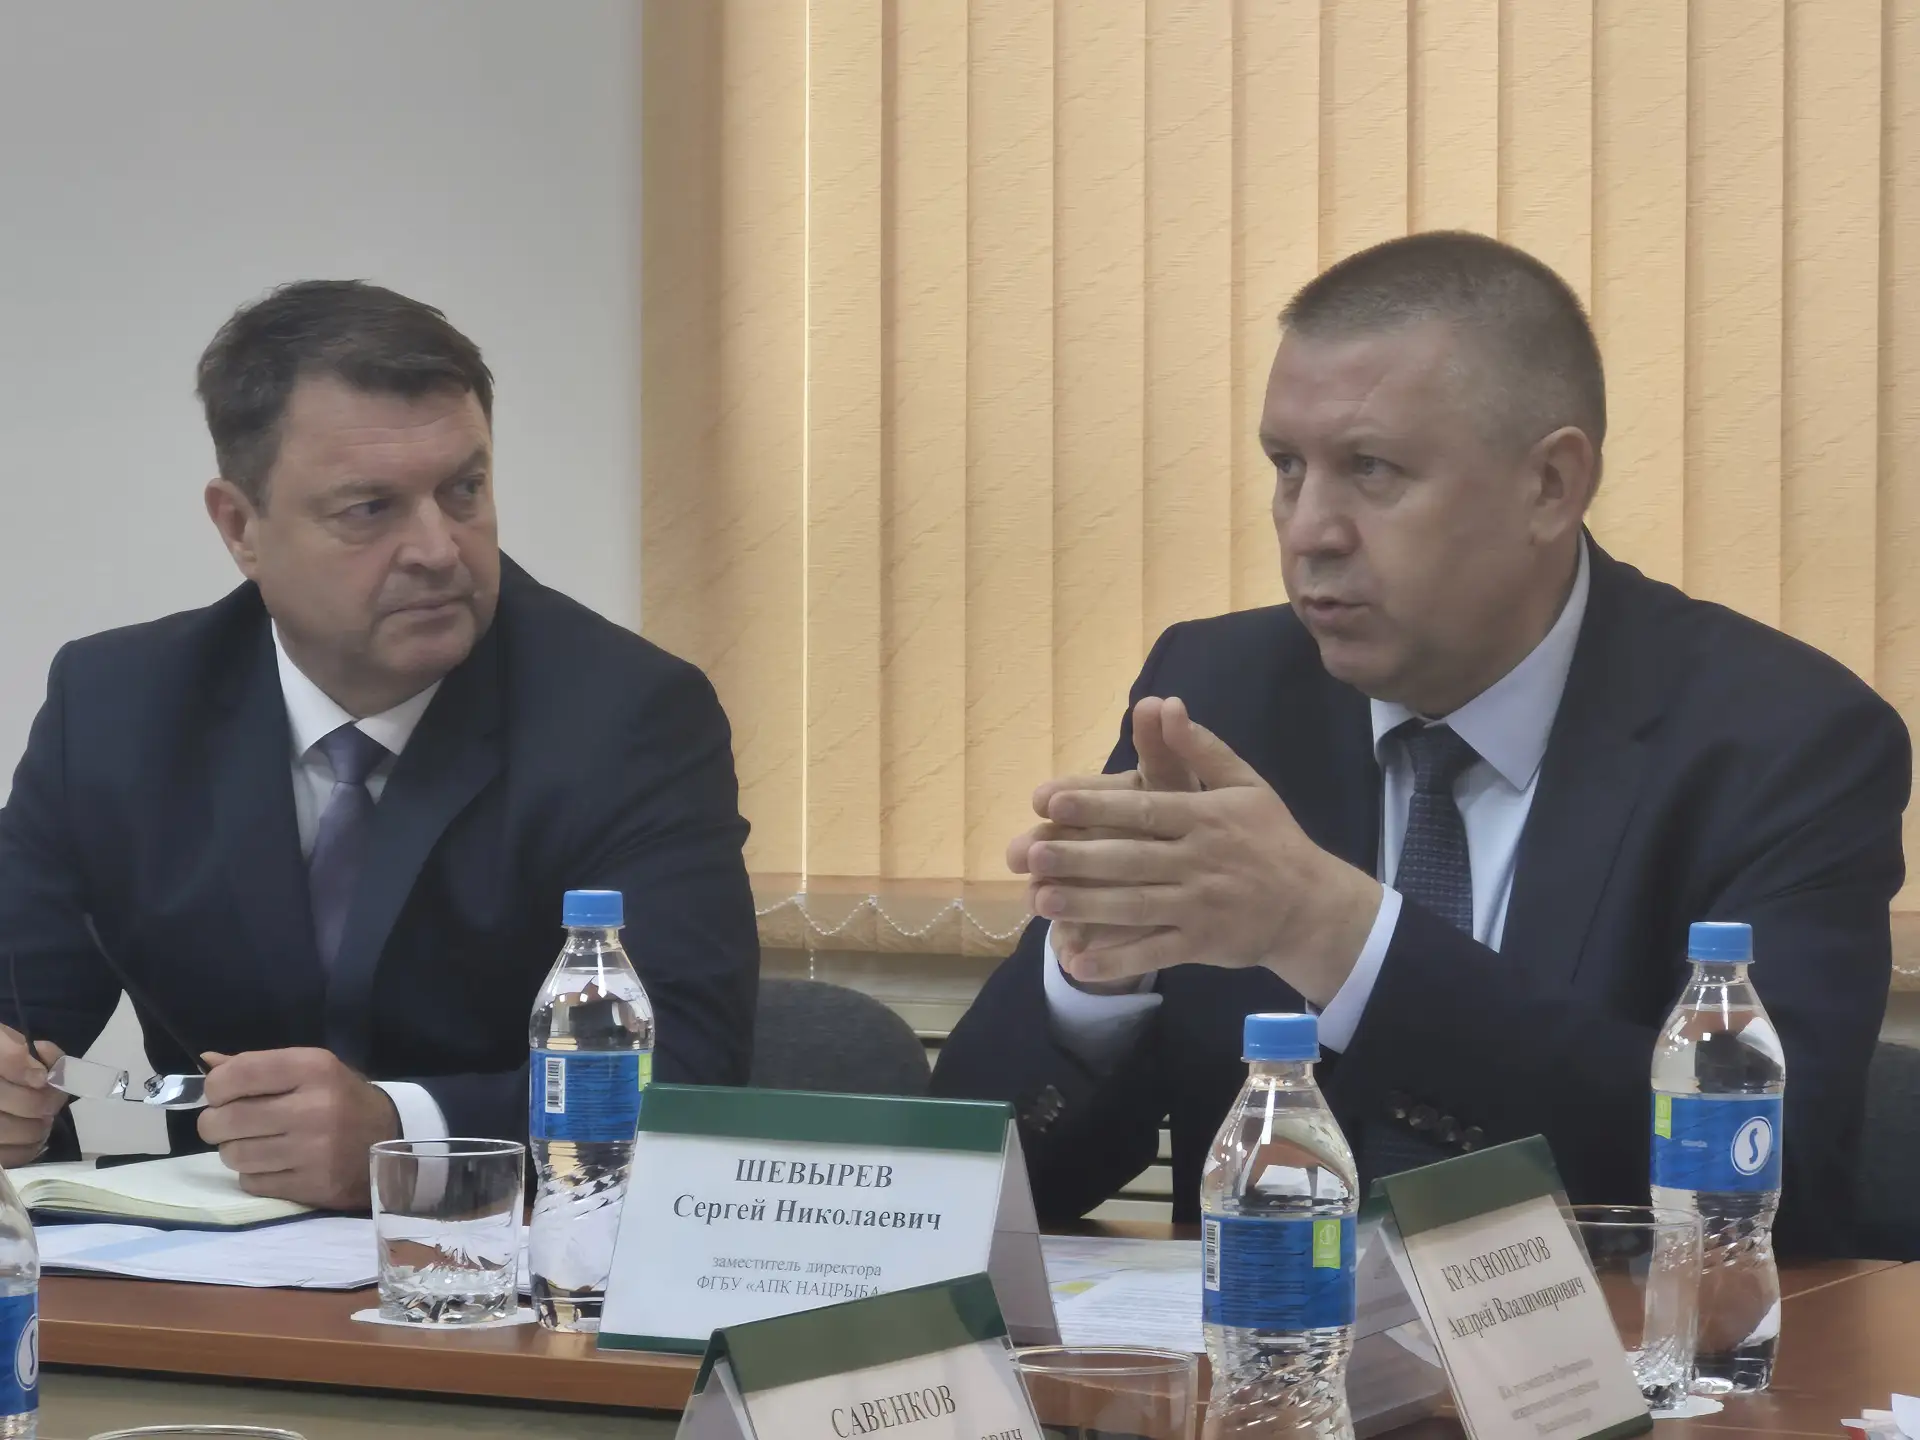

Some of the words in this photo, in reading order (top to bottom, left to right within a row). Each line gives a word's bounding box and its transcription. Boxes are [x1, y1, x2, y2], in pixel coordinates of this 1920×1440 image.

[735, 1158, 893, 1188] ШЕВЫРЕВ
[673, 1194, 765, 1225] Сергей
[775, 1199, 942, 1230] Николаевич
[712, 1256, 802, 1272] заместитель
[805, 1262, 882, 1280] директора
[1441, 1236, 1551, 1292] КРАСНОПЕРОВ
[697, 1275, 743, 1291] ФГБУ
[746, 1279, 793, 1294] «АПК
[796, 1280, 886, 1299] НАЦРЫБА
[1448, 1302, 1498, 1340] Андрей
[1492, 1277, 1586, 1323] Владимирович
[831, 1385, 957, 1439] САВЕНКОВ
